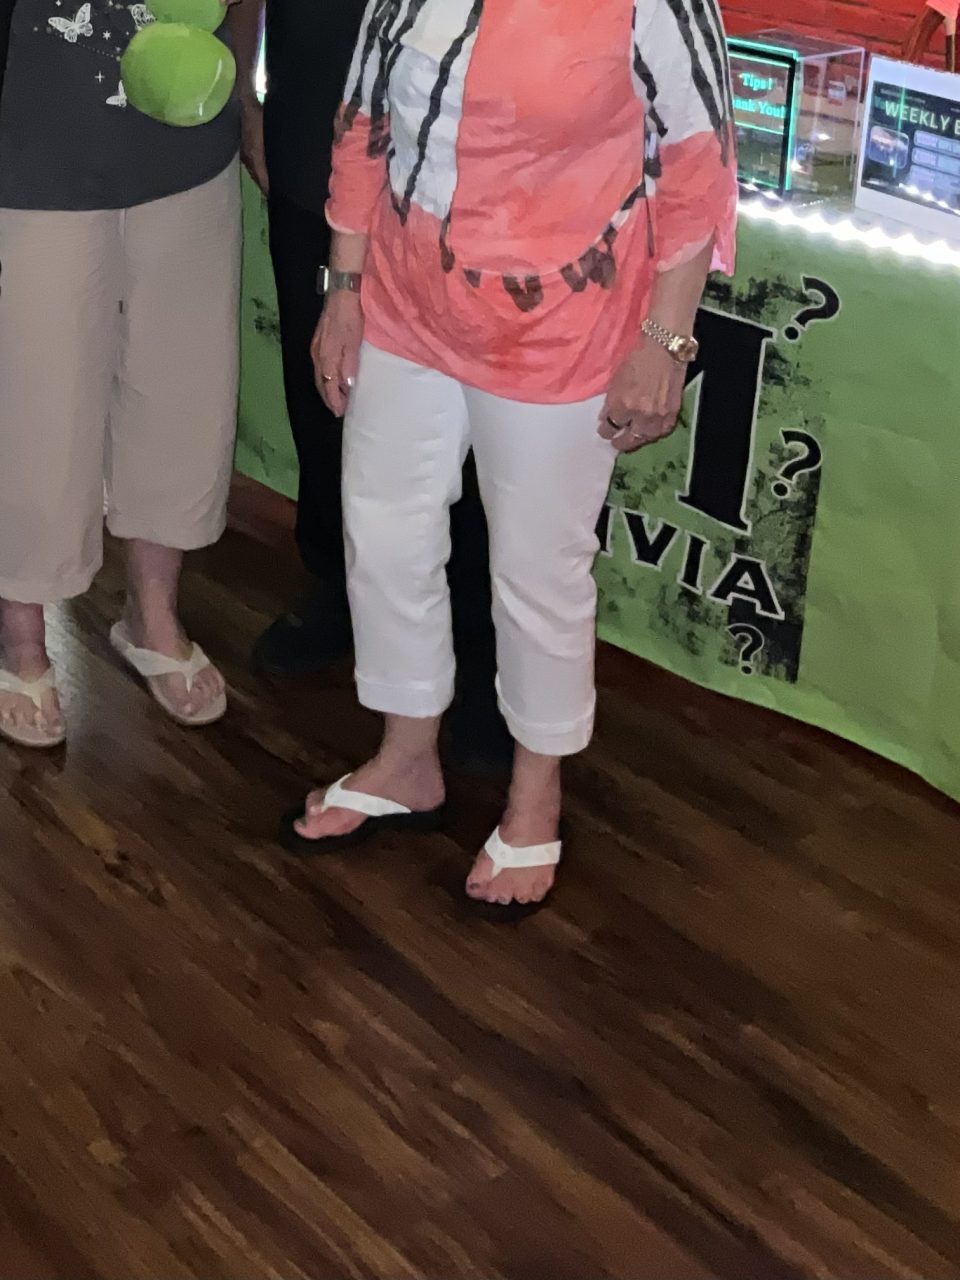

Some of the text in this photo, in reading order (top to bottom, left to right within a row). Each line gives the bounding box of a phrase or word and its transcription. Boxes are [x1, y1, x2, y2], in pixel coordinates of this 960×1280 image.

[739, 73, 773, 91] Tips!
[758, 100, 786, 119] You!
[885, 100, 950, 132] WEEKLY
